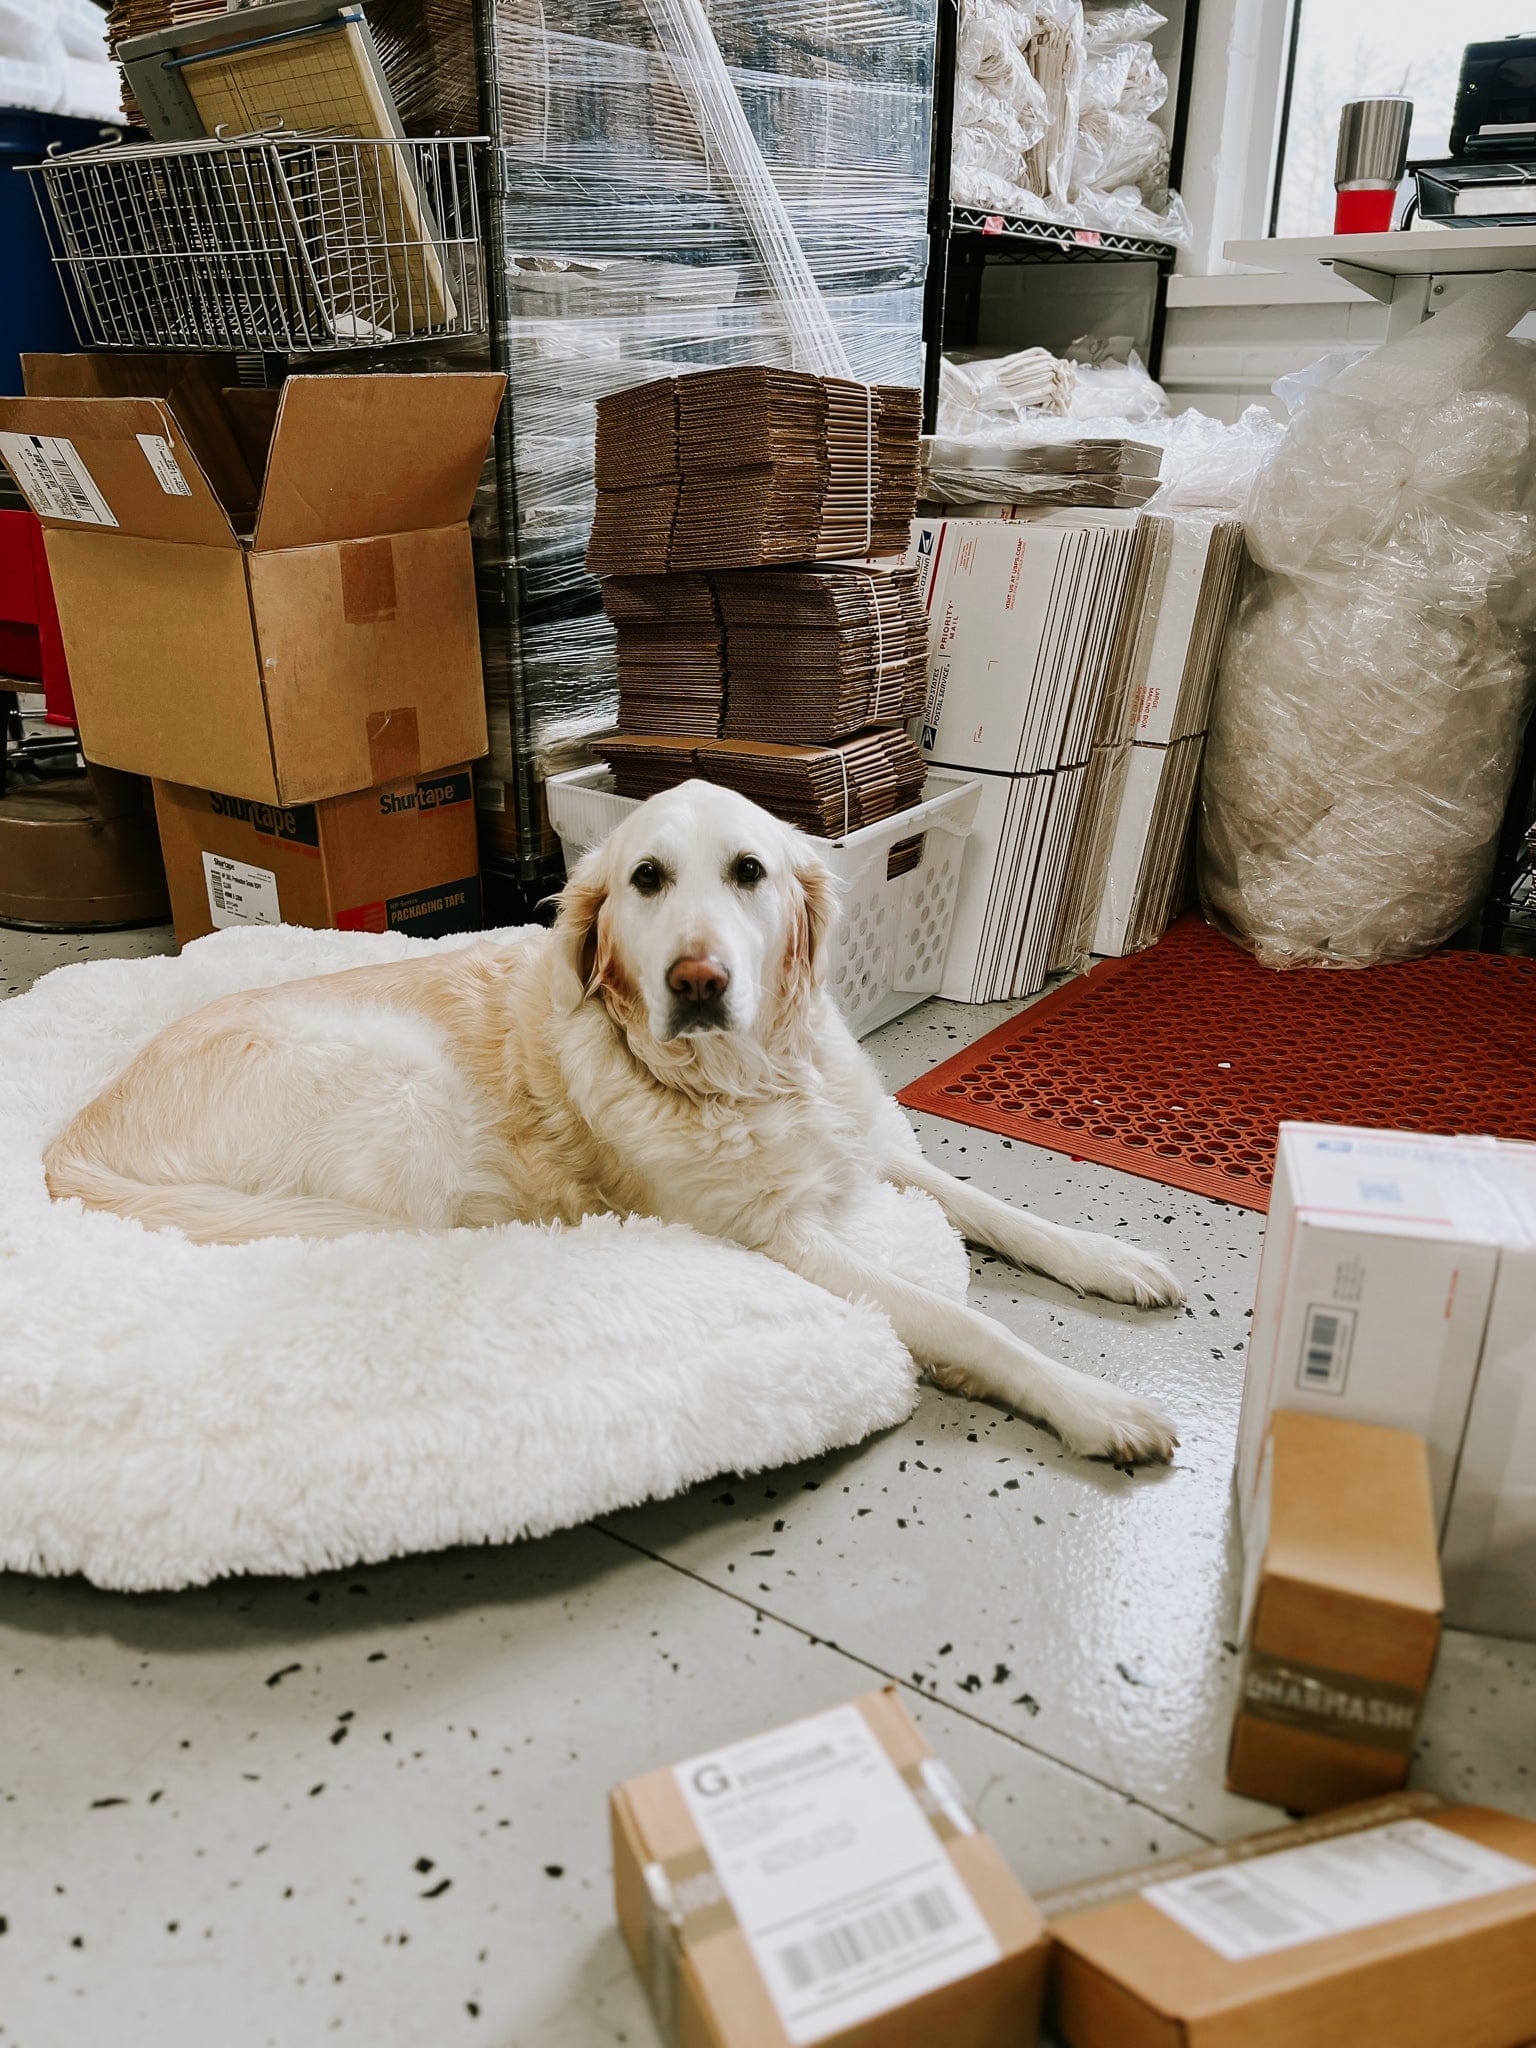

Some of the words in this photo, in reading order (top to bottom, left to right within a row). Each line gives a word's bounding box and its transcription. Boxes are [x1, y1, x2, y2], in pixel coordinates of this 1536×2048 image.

[920, 557, 930, 587] UNITED
[949, 615, 959, 640] MAIL
[924, 695, 935, 723] UNITED
[930, 668, 940, 695] STATES
[933, 698, 945, 727] POSTAL
[379, 784, 455, 816] Shurtape
[391, 899, 443, 923] PACKAGING
[443, 892, 466, 909] TAPE
[692, 1762, 731, 1798] G
